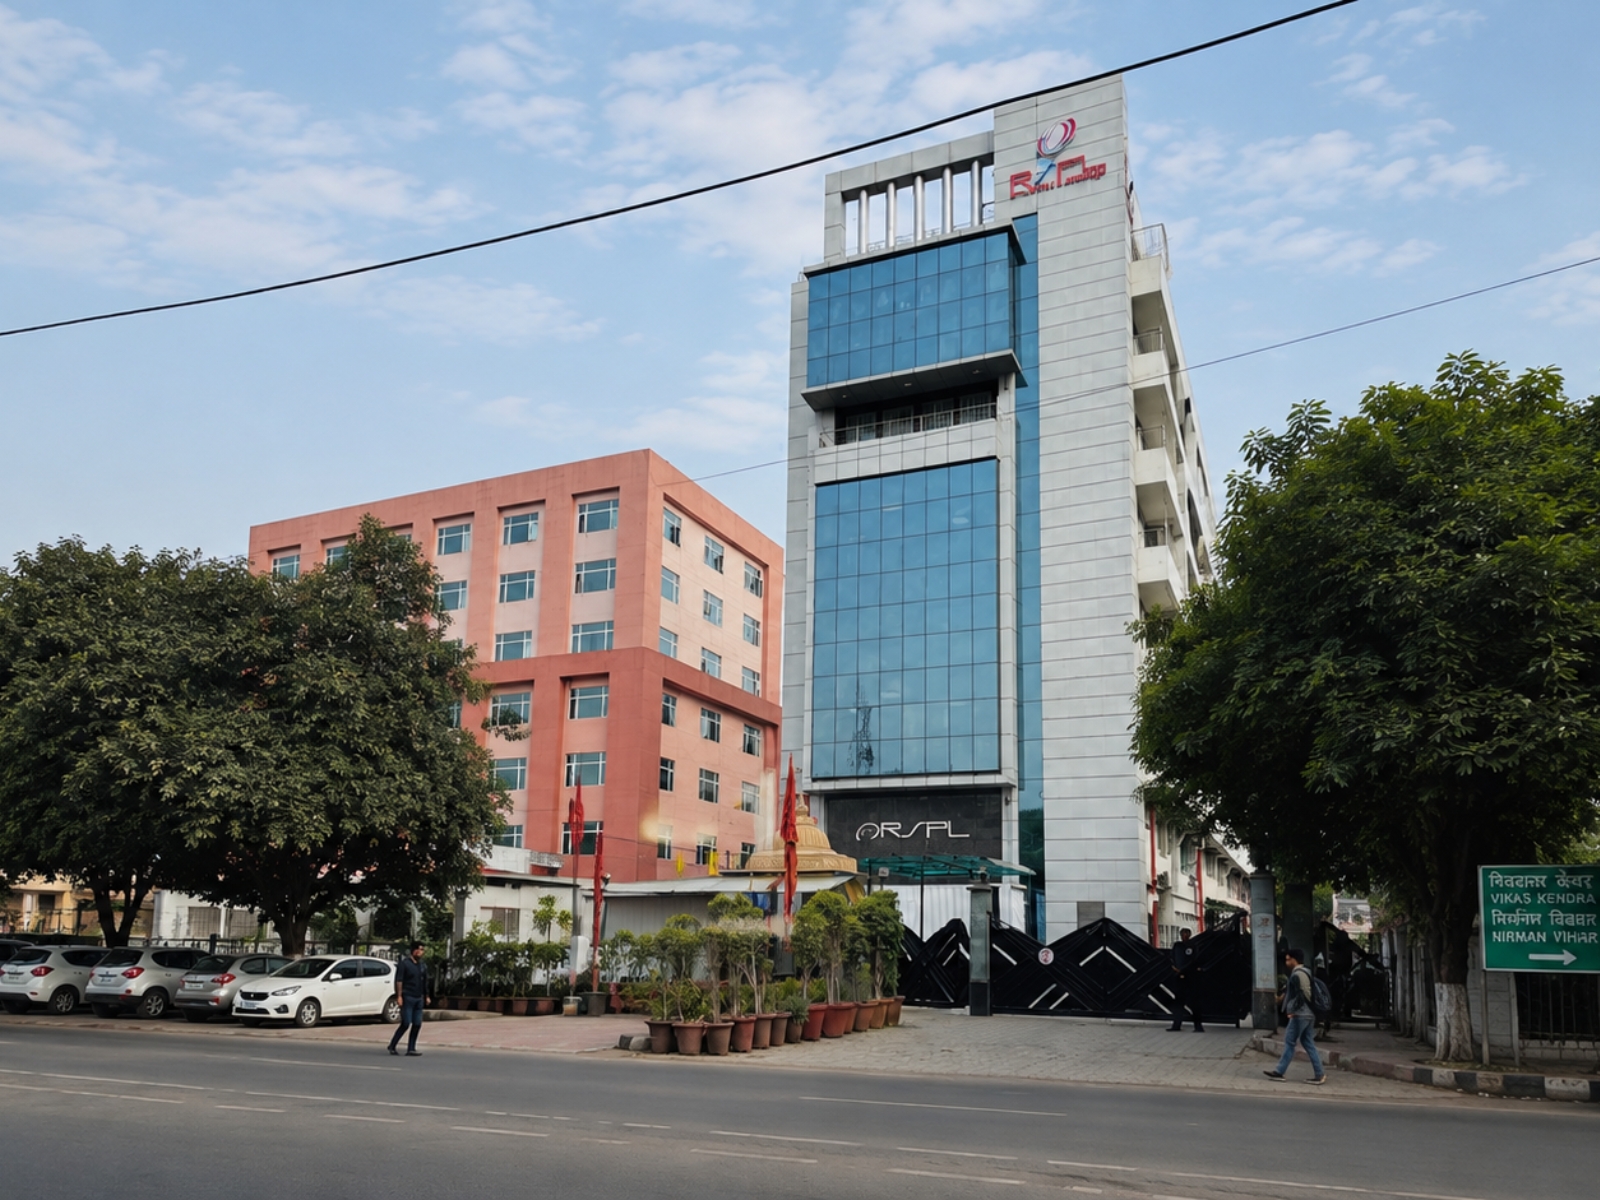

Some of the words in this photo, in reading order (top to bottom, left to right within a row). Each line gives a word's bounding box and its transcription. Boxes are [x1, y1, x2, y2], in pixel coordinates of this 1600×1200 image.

[1490, 893, 1532, 905] VIKAS
[1537, 893, 1596, 904] KENDRA
[1492, 931, 1546, 943] NIRMAN
[1553, 930, 1598, 943] VIHAR
